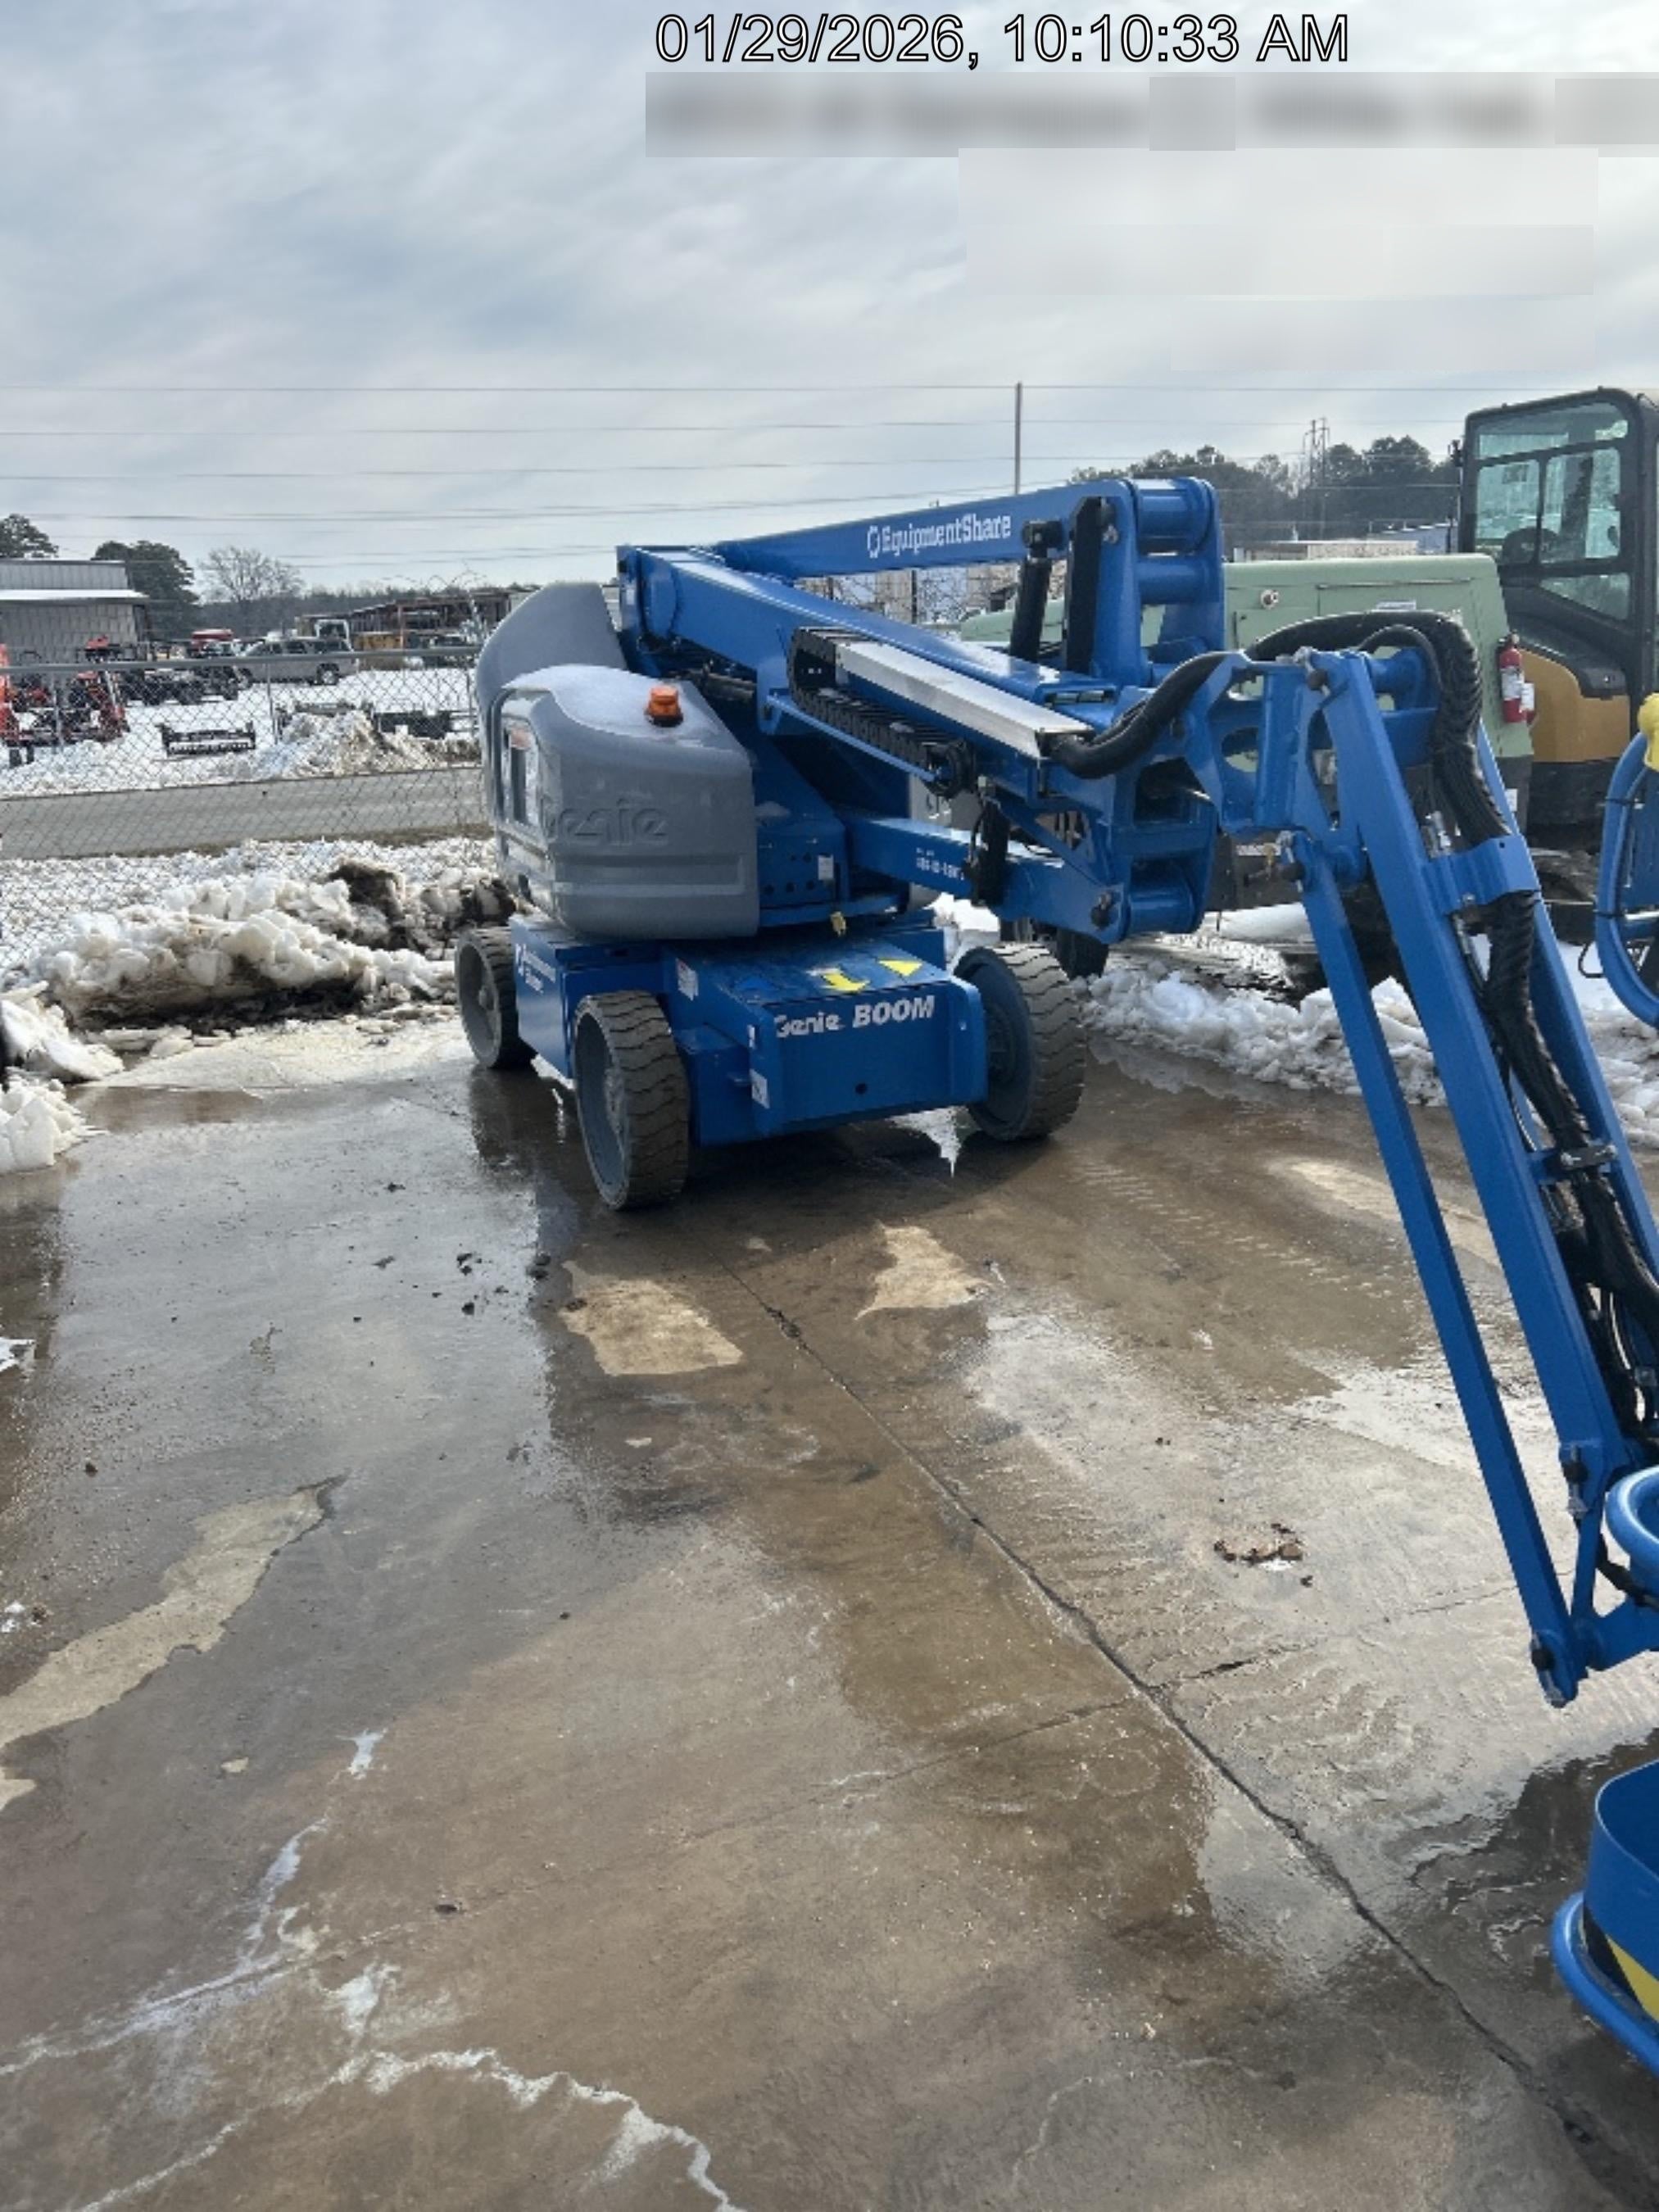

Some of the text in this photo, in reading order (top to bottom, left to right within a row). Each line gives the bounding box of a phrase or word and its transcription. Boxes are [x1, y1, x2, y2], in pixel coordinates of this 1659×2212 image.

[882, 513, 1012, 556] EquipmentShare
[774, 995, 936, 1038] Genie BOOM
